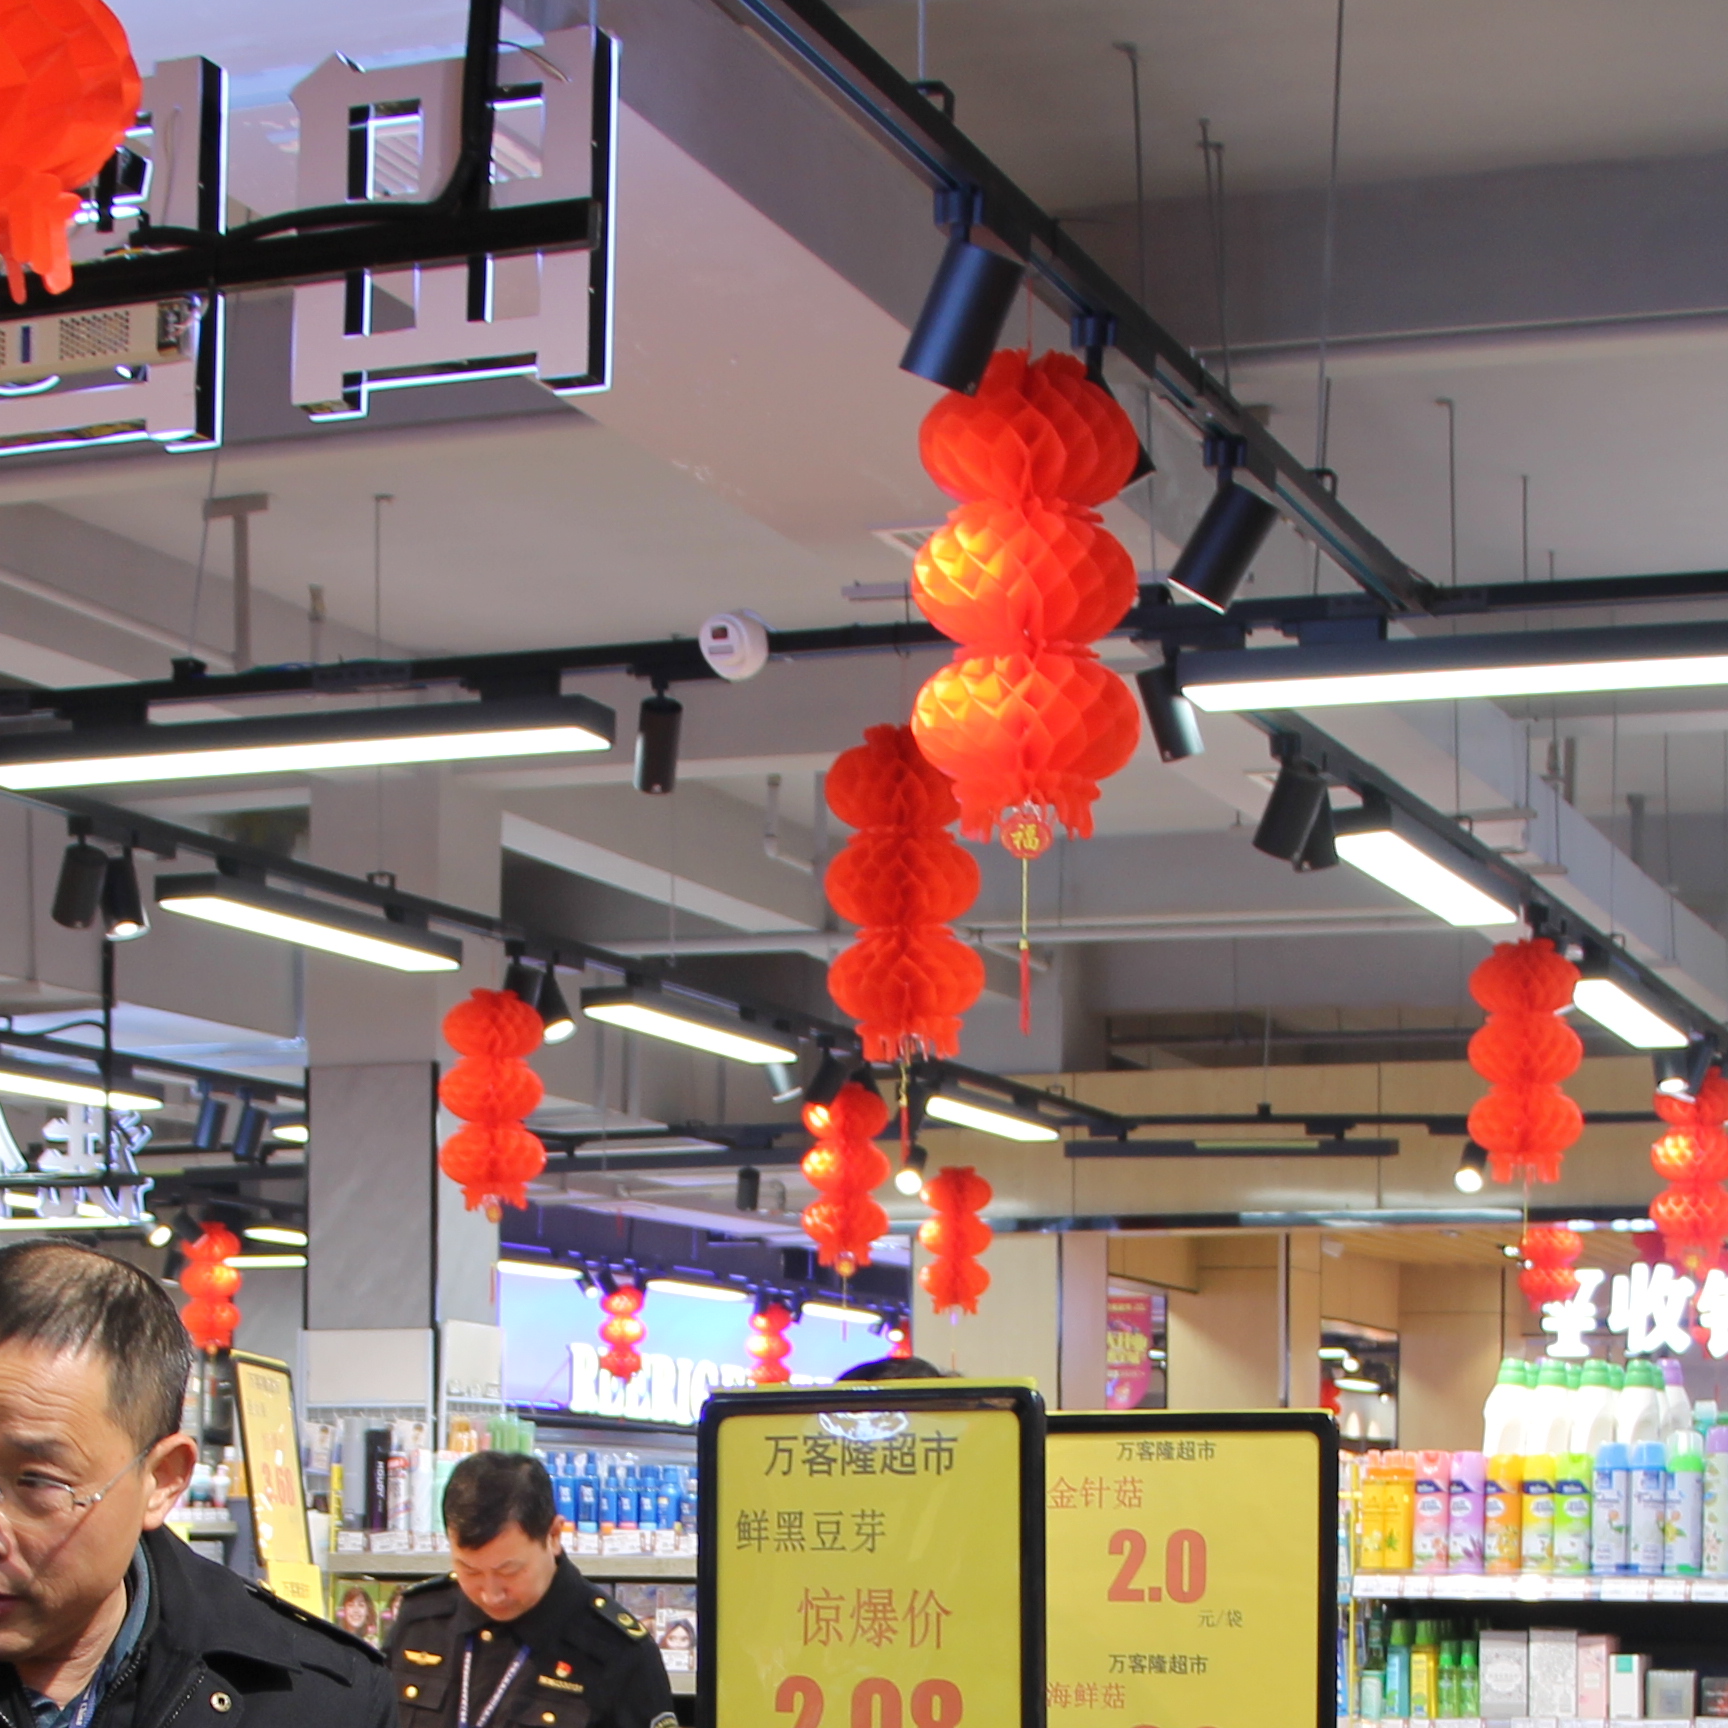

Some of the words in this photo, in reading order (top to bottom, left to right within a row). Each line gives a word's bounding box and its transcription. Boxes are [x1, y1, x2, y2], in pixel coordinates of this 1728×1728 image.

[763, 1431, 958, 1478] 万客隆超市
[1116, 1439, 1217, 1462] 万客隆超市
[1047, 1476, 1144, 1511] 金针菇
[735, 1508, 886, 1555] 鲜黑豆芽
[1107, 1528, 1207, 1604] 2.0
[797, 1586, 953, 1650] 惊爆价
[1197, 1609, 1244, 1628] 元/袋
[1108, 1653, 1209, 1676] 万客隆超市
[1046, 1682, 1127, 1710] 海鲜菇
